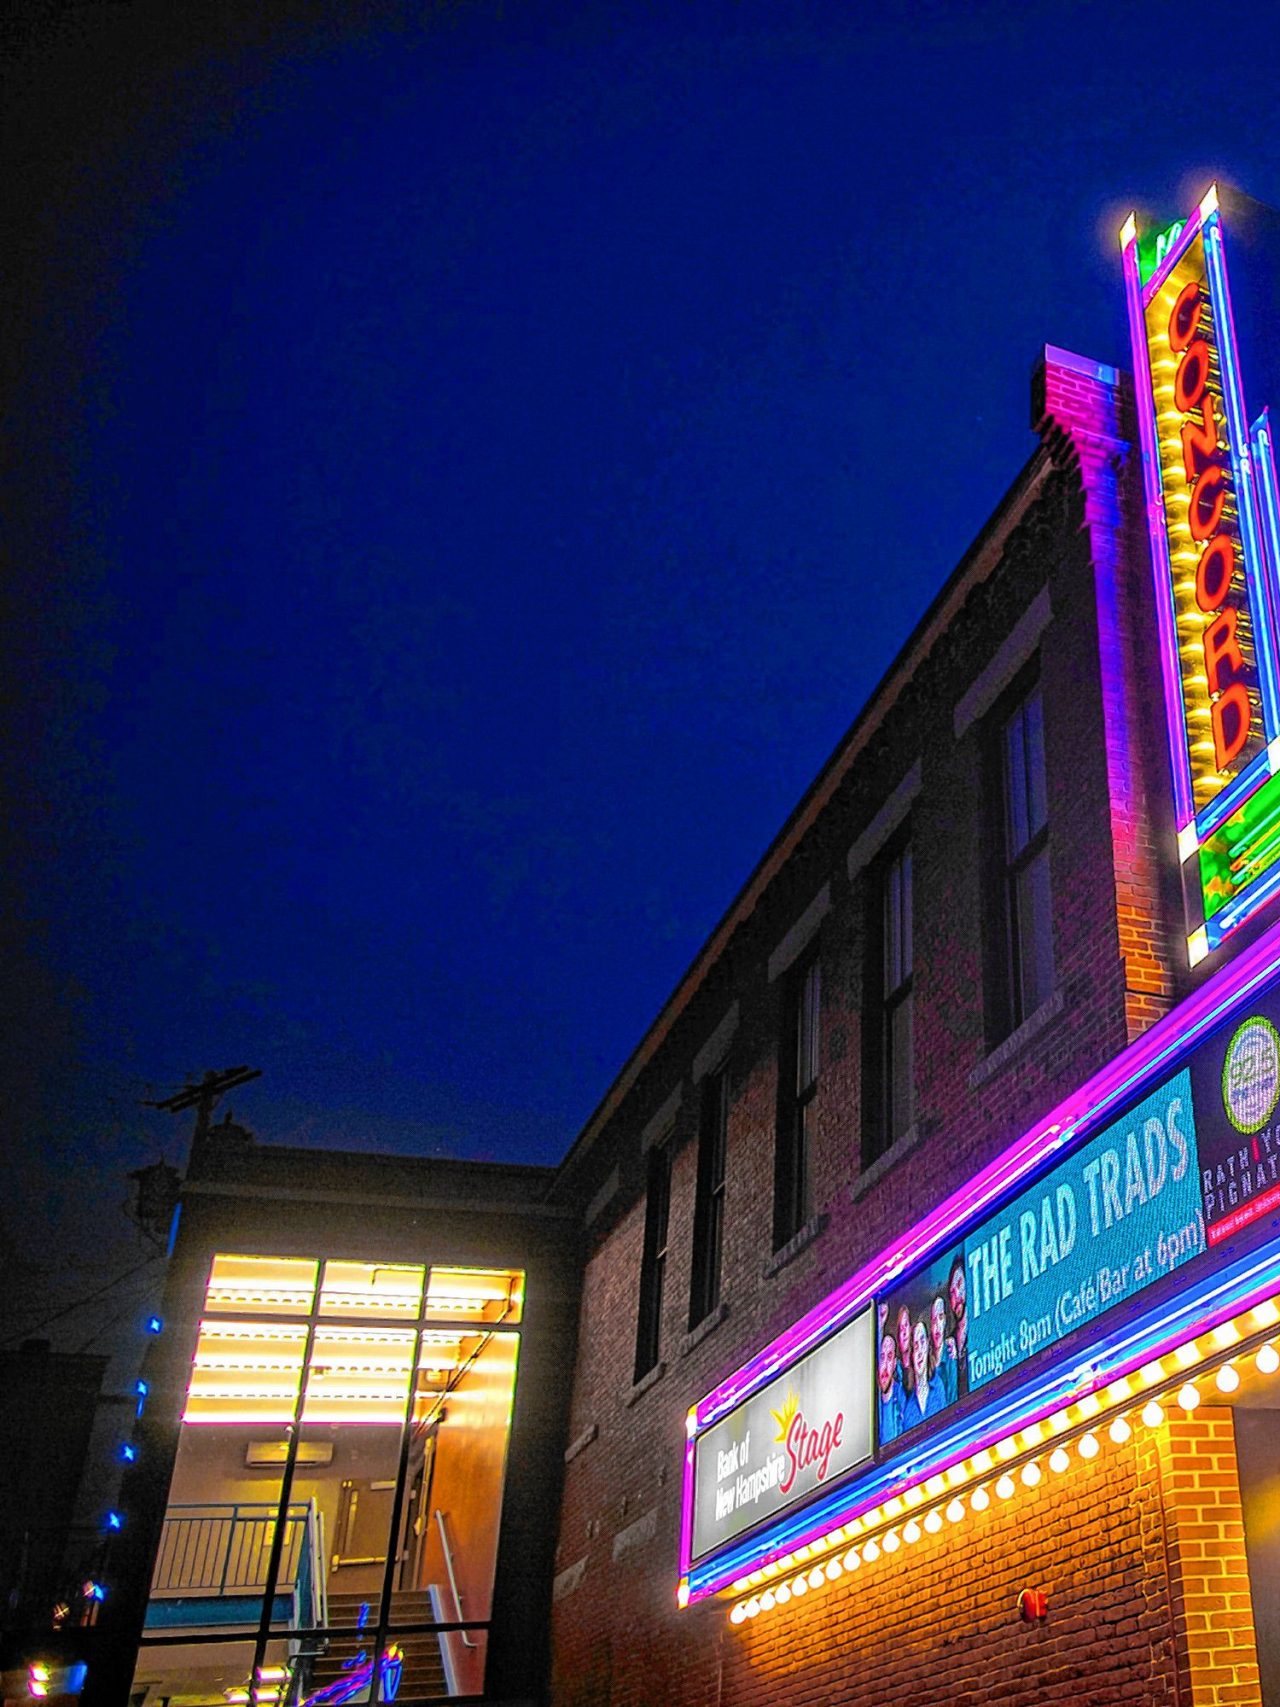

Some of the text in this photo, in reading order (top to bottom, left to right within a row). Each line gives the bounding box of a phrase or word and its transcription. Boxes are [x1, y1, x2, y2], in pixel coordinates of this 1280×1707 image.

[1168, 281, 1252, 772] CONCORD
[968, 1224, 1014, 1319] THE
[1019, 1182, 1077, 1285] RAD
[1083, 1098, 1188, 1237] TRADS
[1203, 1147, 1249, 1194] RATH
[967, 1330, 1017, 1384] Tonight
[1020, 1313, 1052, 1357] 8pm
[1133, 1245, 1153, 1281] at
[1157, 1207, 1206, 1272] 6pm)
[715, 1452, 786, 1522] New Hampshire
[717, 1430, 751, 1483] Bank of
[779, 1411, 844, 1495] Stage
